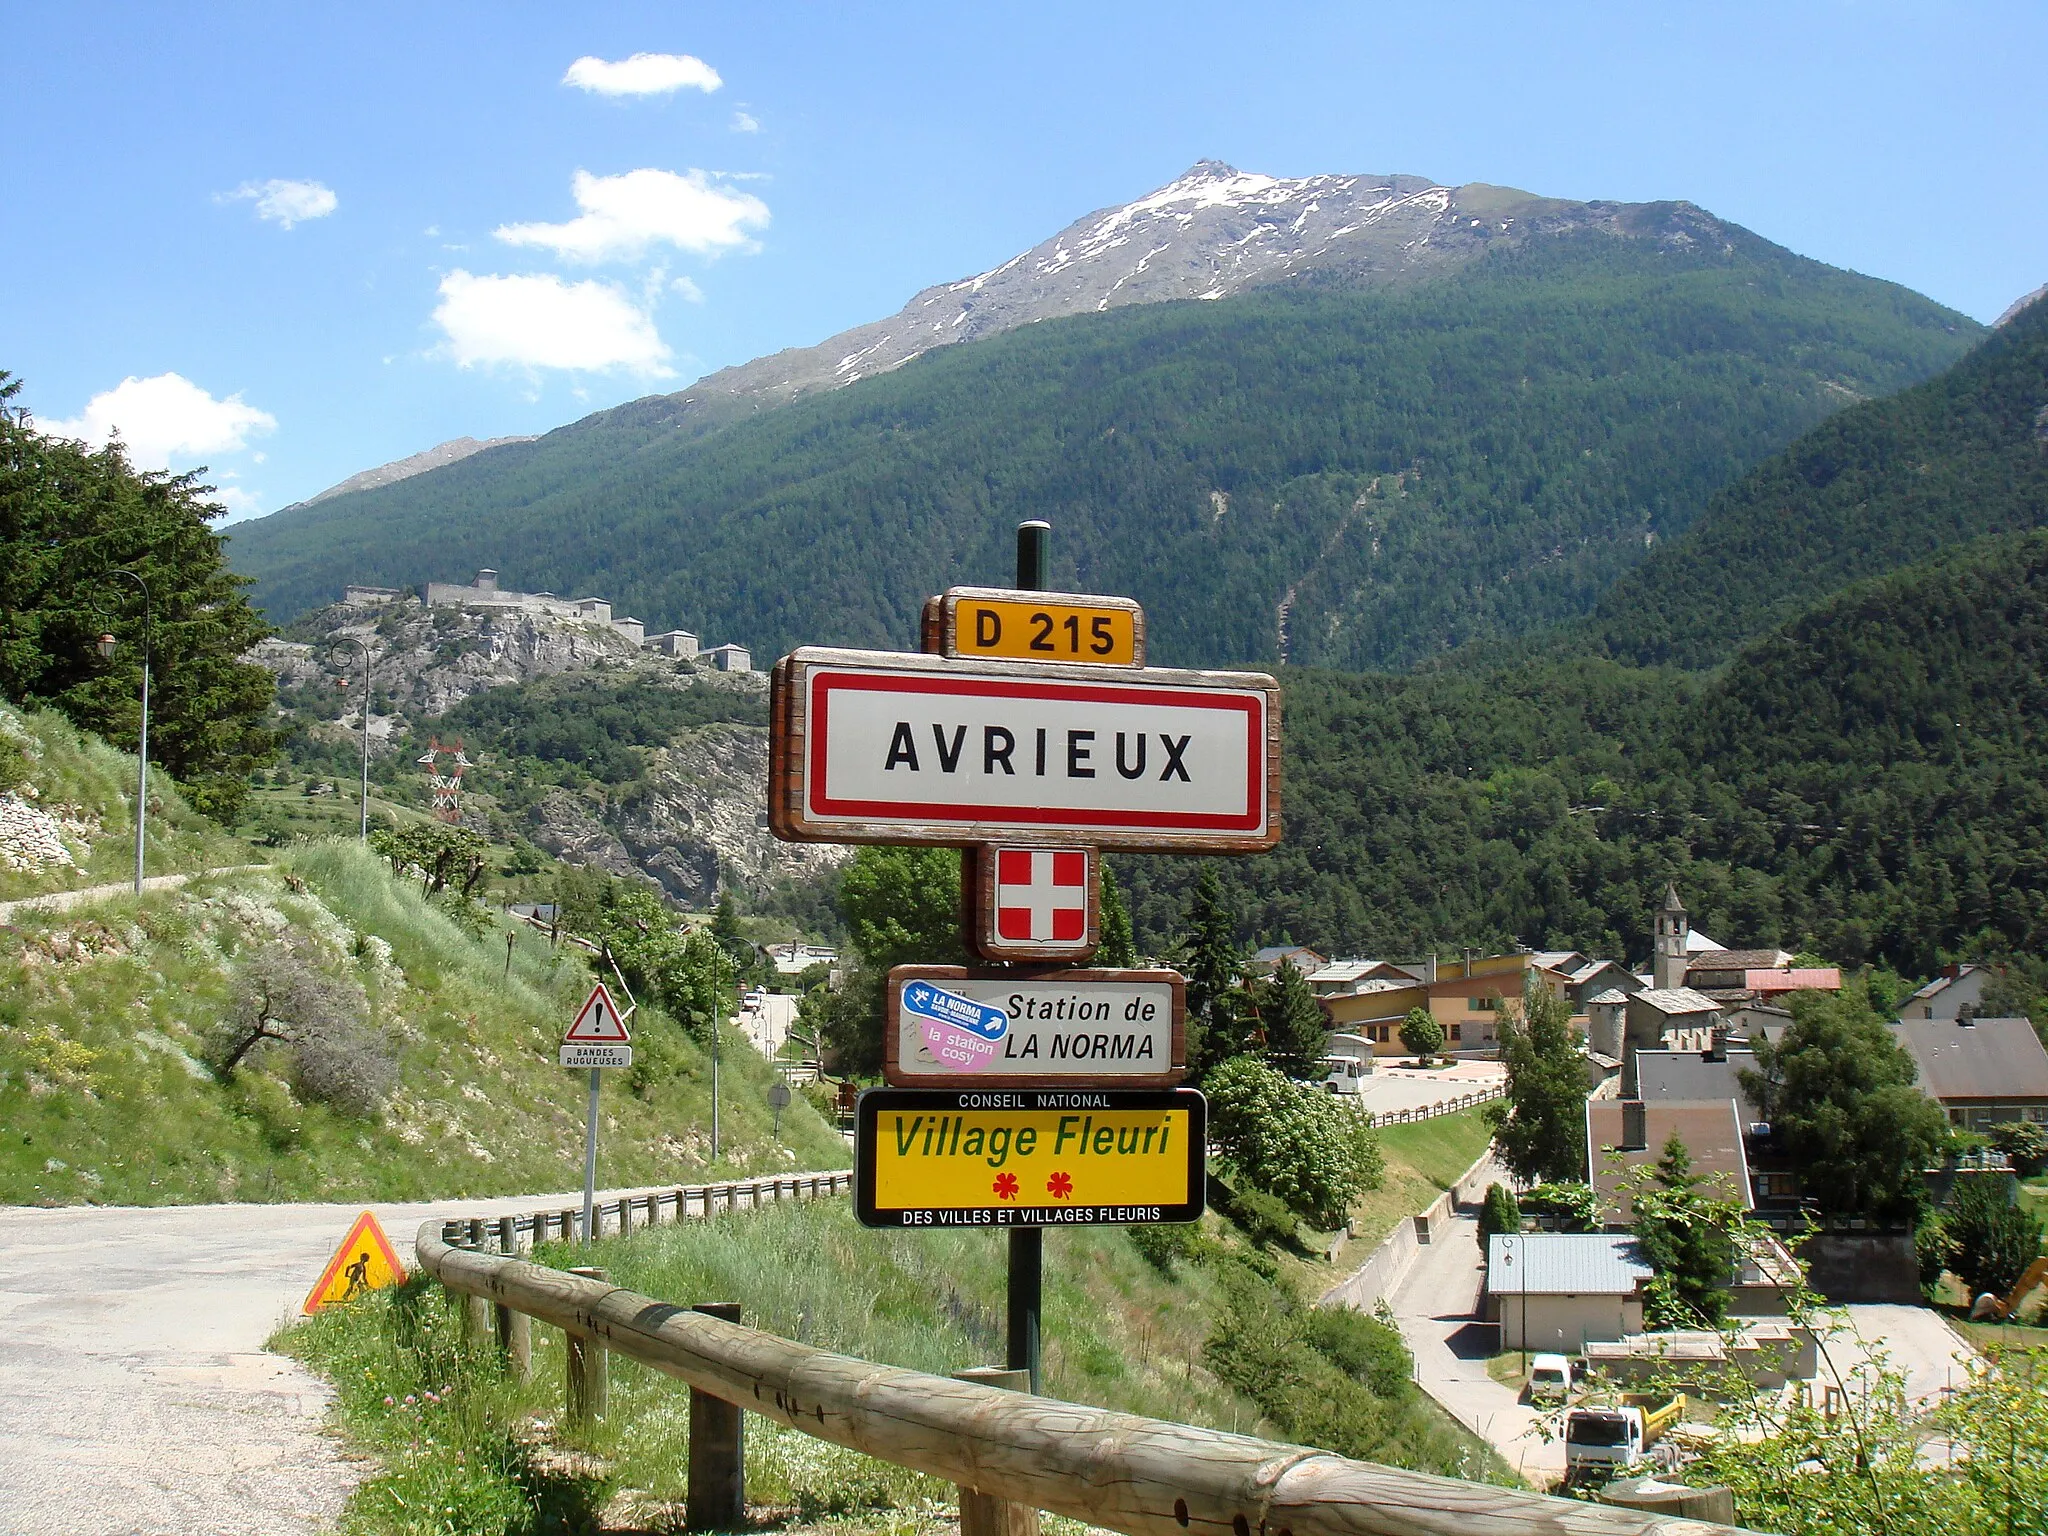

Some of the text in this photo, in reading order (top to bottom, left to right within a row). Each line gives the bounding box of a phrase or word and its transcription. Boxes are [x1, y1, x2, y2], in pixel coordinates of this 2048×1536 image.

[976, 609, 1114, 655] D 215
[884, 722, 1192, 782] AVRIEUX
[932, 993, 945, 1005] LA
[947, 998, 981, 1019] NORMA
[1007, 994, 1155, 1021] Station de
[928, 1027, 993, 1055] la station
[1004, 1034, 1154, 1059] LA NORMA
[942, 1047, 974, 1065] cosy
[958, 1094, 1110, 1108] CONSEIL NATIONAL
[895, 1116, 1171, 1168] Village Fleuri
[903, 1207, 1161, 1224] DES VILLES ET VILLAGES FLEURIS
